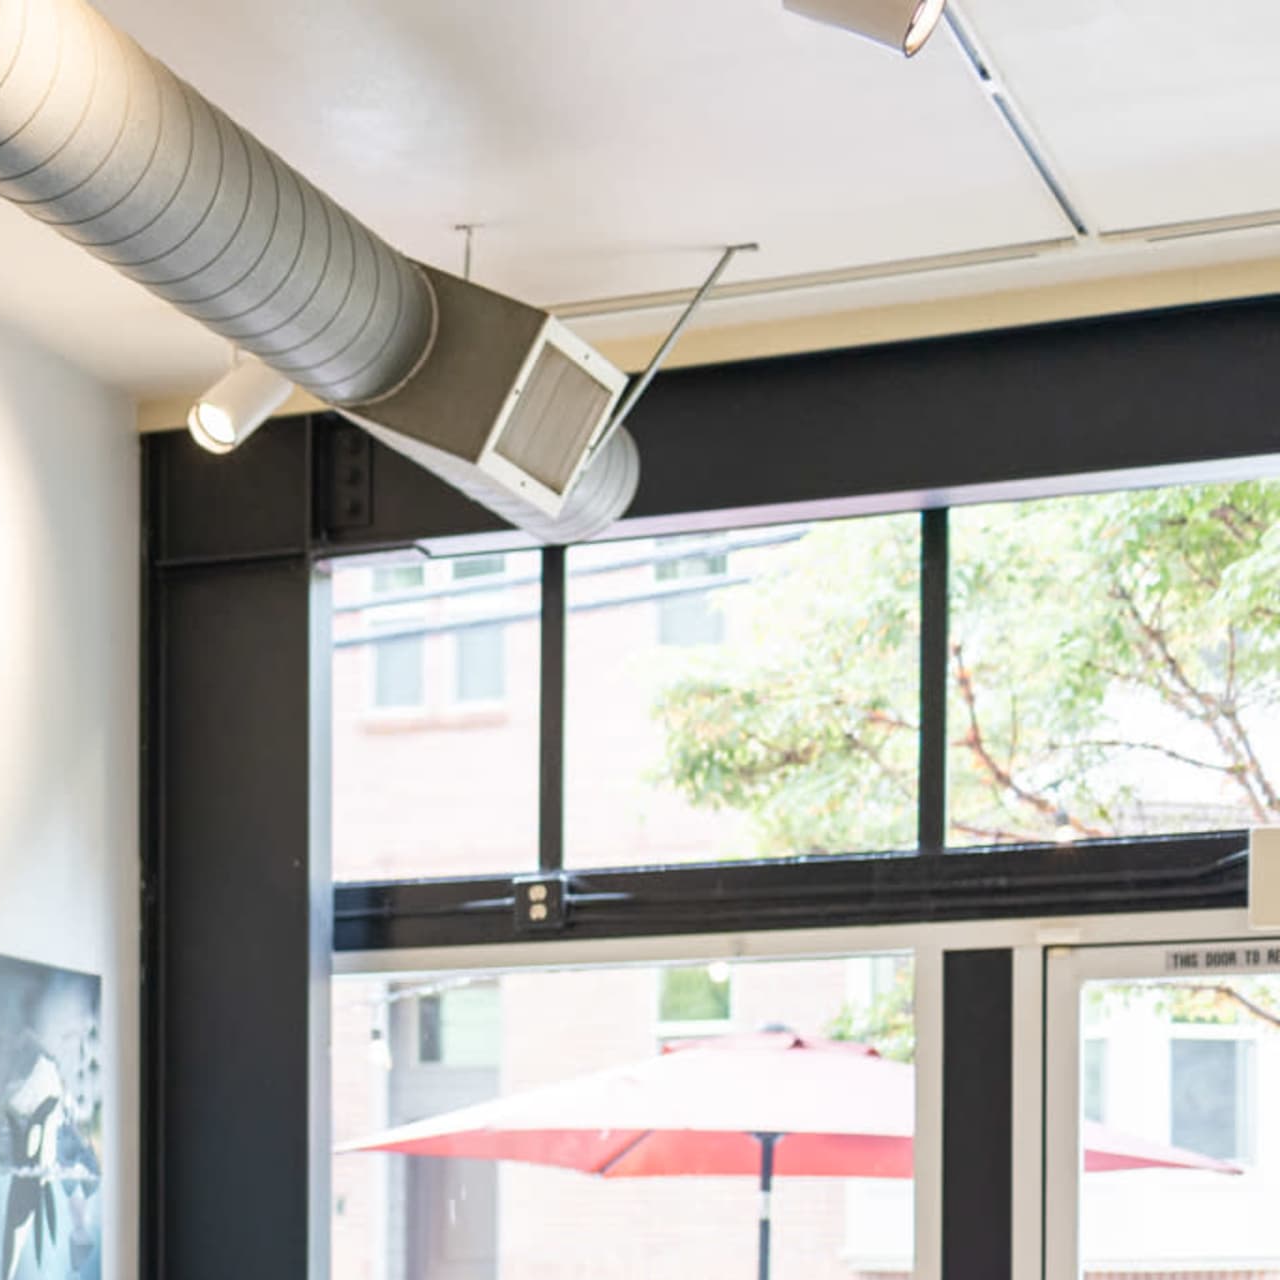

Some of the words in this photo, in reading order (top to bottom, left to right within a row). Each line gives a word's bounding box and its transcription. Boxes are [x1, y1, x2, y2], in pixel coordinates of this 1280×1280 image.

[1171, 952, 1199, 969] THIS
[1205, 951, 1237, 969] DOOR
[1245, 949, 1260, 967] TO
